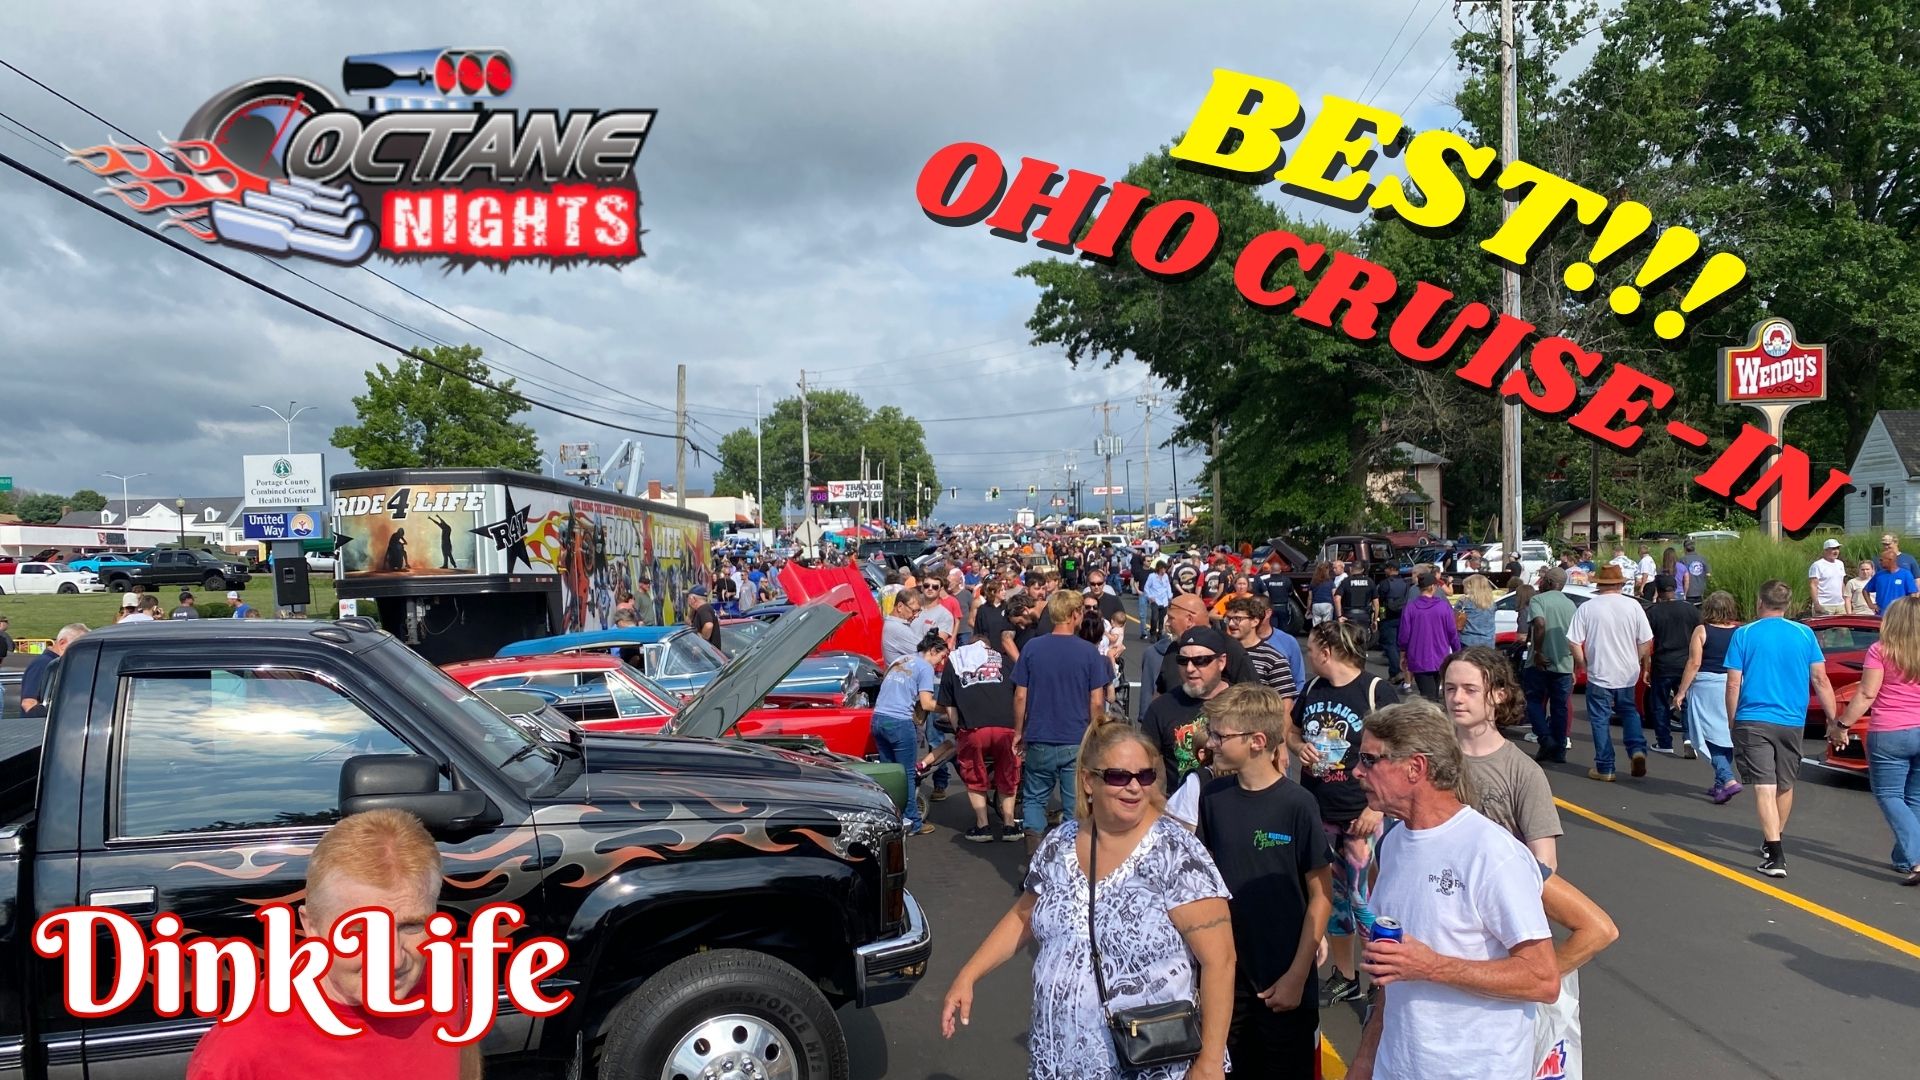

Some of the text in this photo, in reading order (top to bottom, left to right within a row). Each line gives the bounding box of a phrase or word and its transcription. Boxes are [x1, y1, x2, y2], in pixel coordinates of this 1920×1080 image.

[284, 479, 311, 487] County
[251, 487, 317, 496] Combined General
[283, 496, 310, 504] District
[333, 487, 487, 521] RIDE 4 LIFE
[248, 514, 285, 525] United
[263, 525, 285, 538] Way
[488, 511, 529, 551] R4L
[653, 525, 681, 559] LIFE
